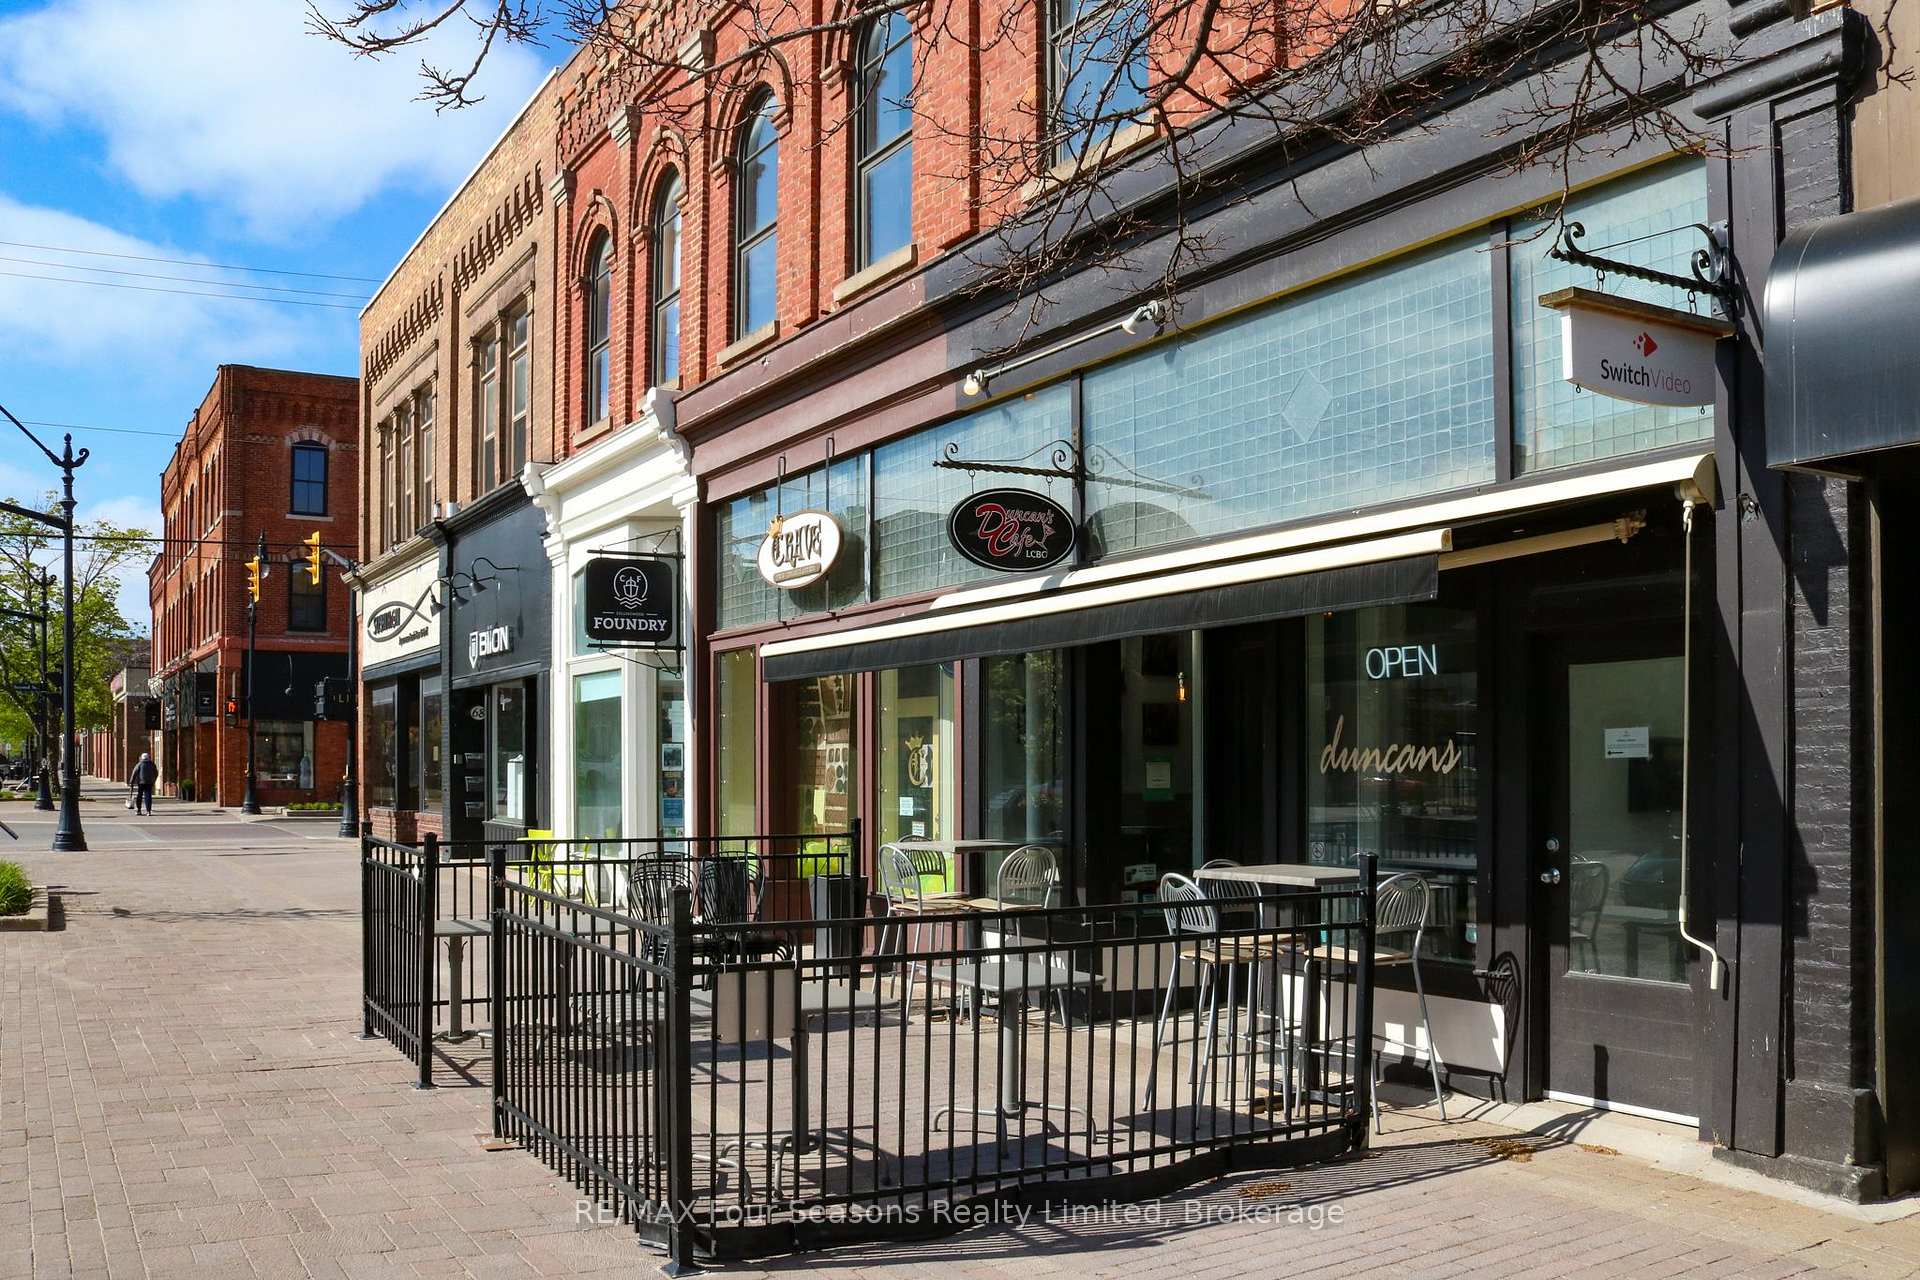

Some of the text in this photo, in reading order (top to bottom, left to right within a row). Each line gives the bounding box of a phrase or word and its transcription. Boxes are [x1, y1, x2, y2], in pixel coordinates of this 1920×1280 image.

[1600, 358, 1692, 395] SwitchVideo
[975, 503, 1055, 540] Duncan's
[772, 519, 822, 568] CRAVE
[636, 575, 642, 583] F
[593, 616, 668, 632] FOUNDRY
[1365, 643, 1438, 679] OPEN
[1320, 714, 1462, 775] duncans
